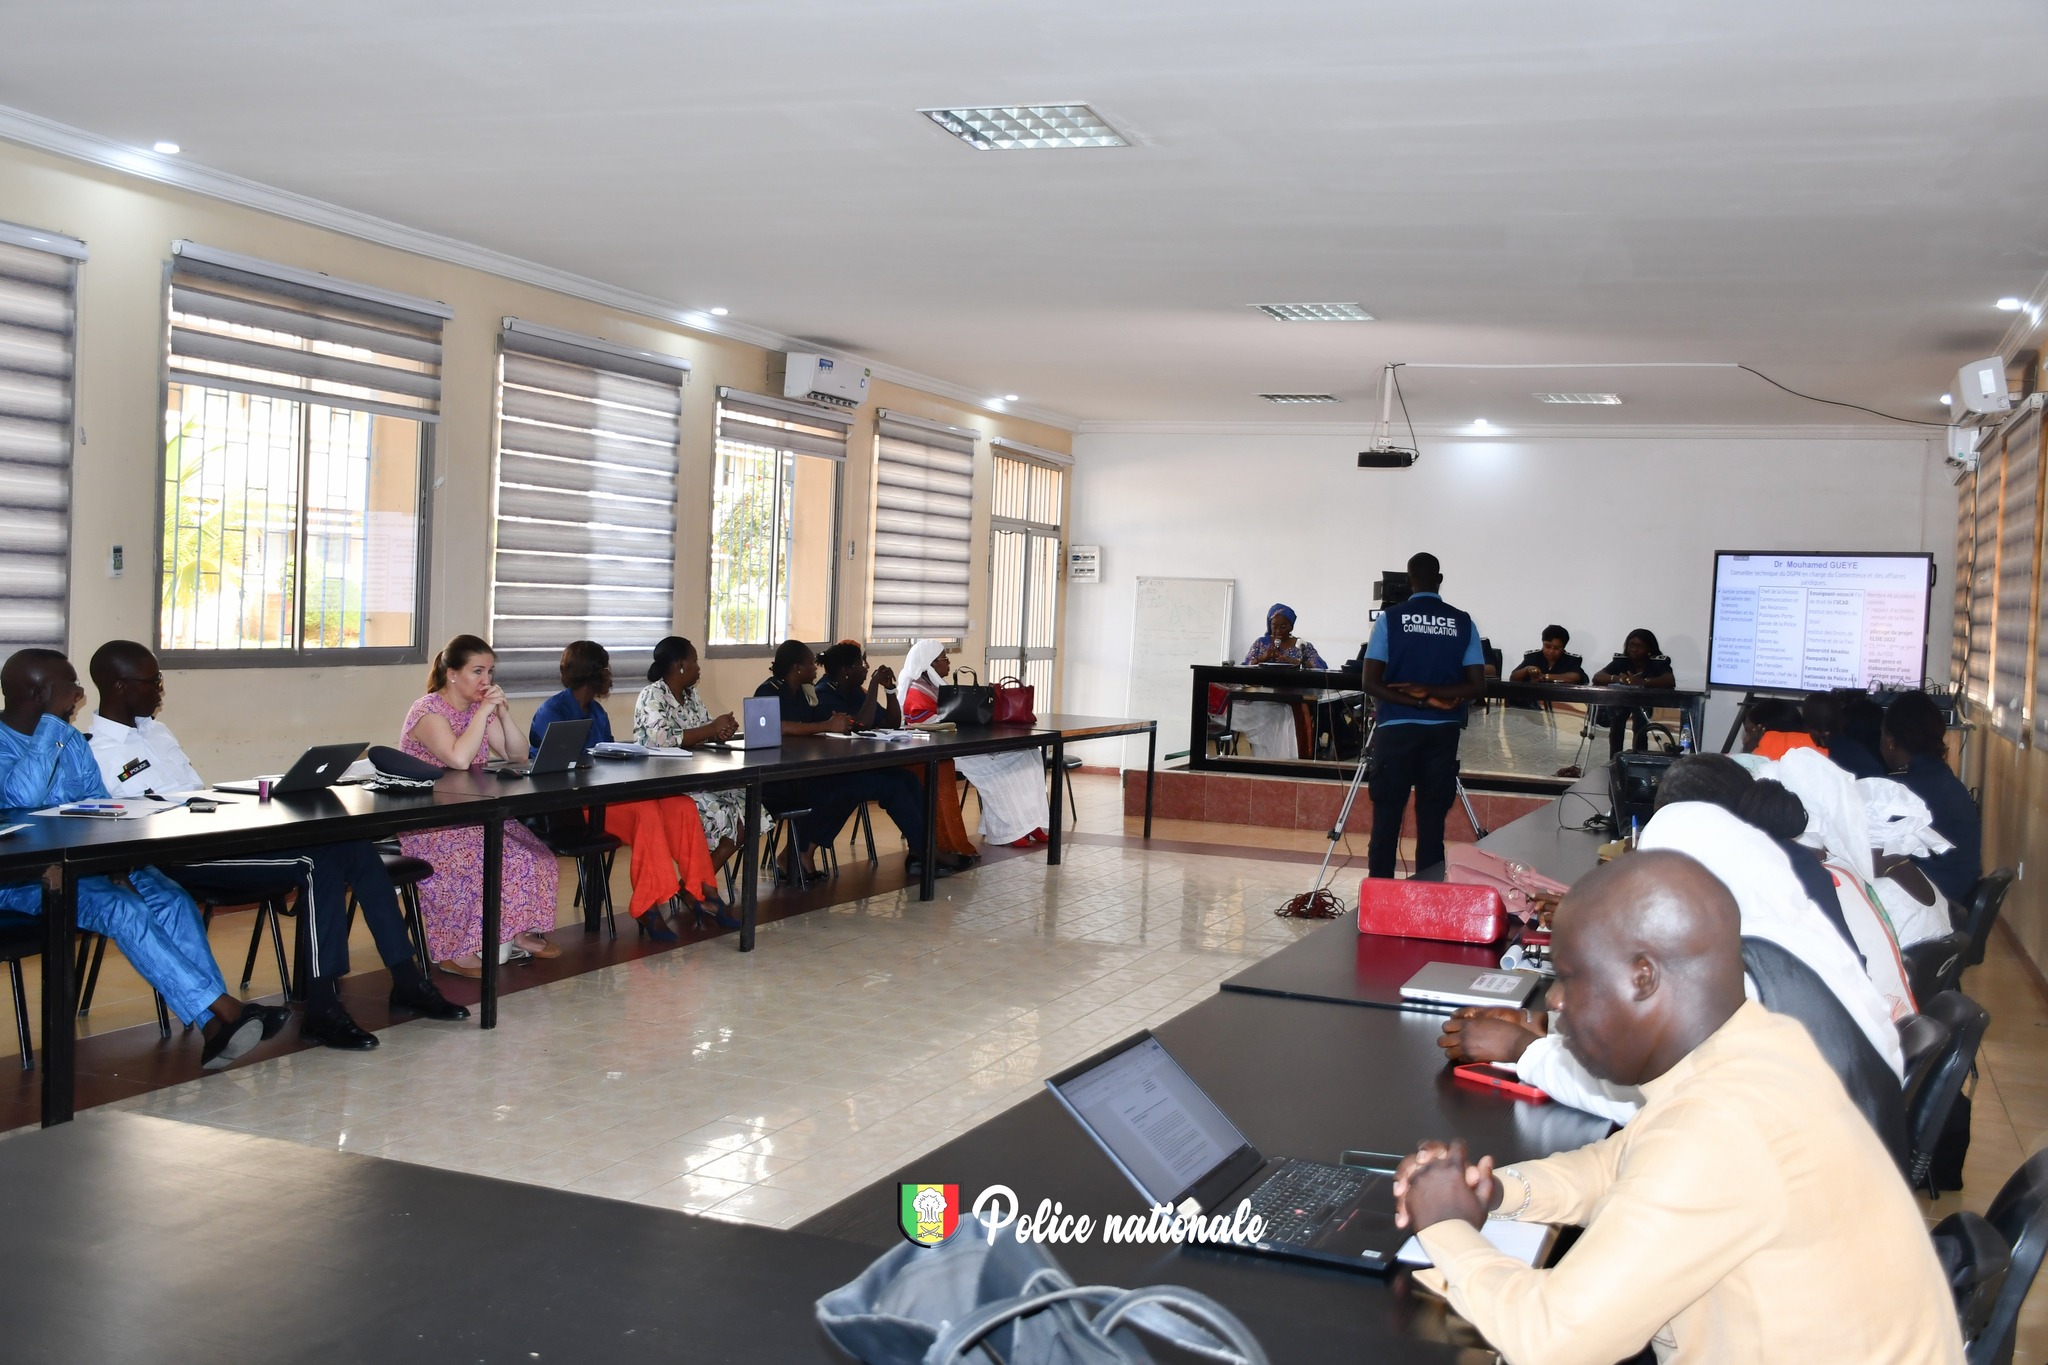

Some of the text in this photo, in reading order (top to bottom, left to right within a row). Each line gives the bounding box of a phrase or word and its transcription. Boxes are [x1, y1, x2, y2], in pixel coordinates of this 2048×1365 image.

[1774, 561, 1858, 569] Dr Mouhamed GUEYE
[1754, 570, 1778, 578] technique
[1401, 614, 1456, 628] POLICE
[1403, 624, 1458, 637] COMMUNICATION
[130, 762, 148, 774] POLICE
